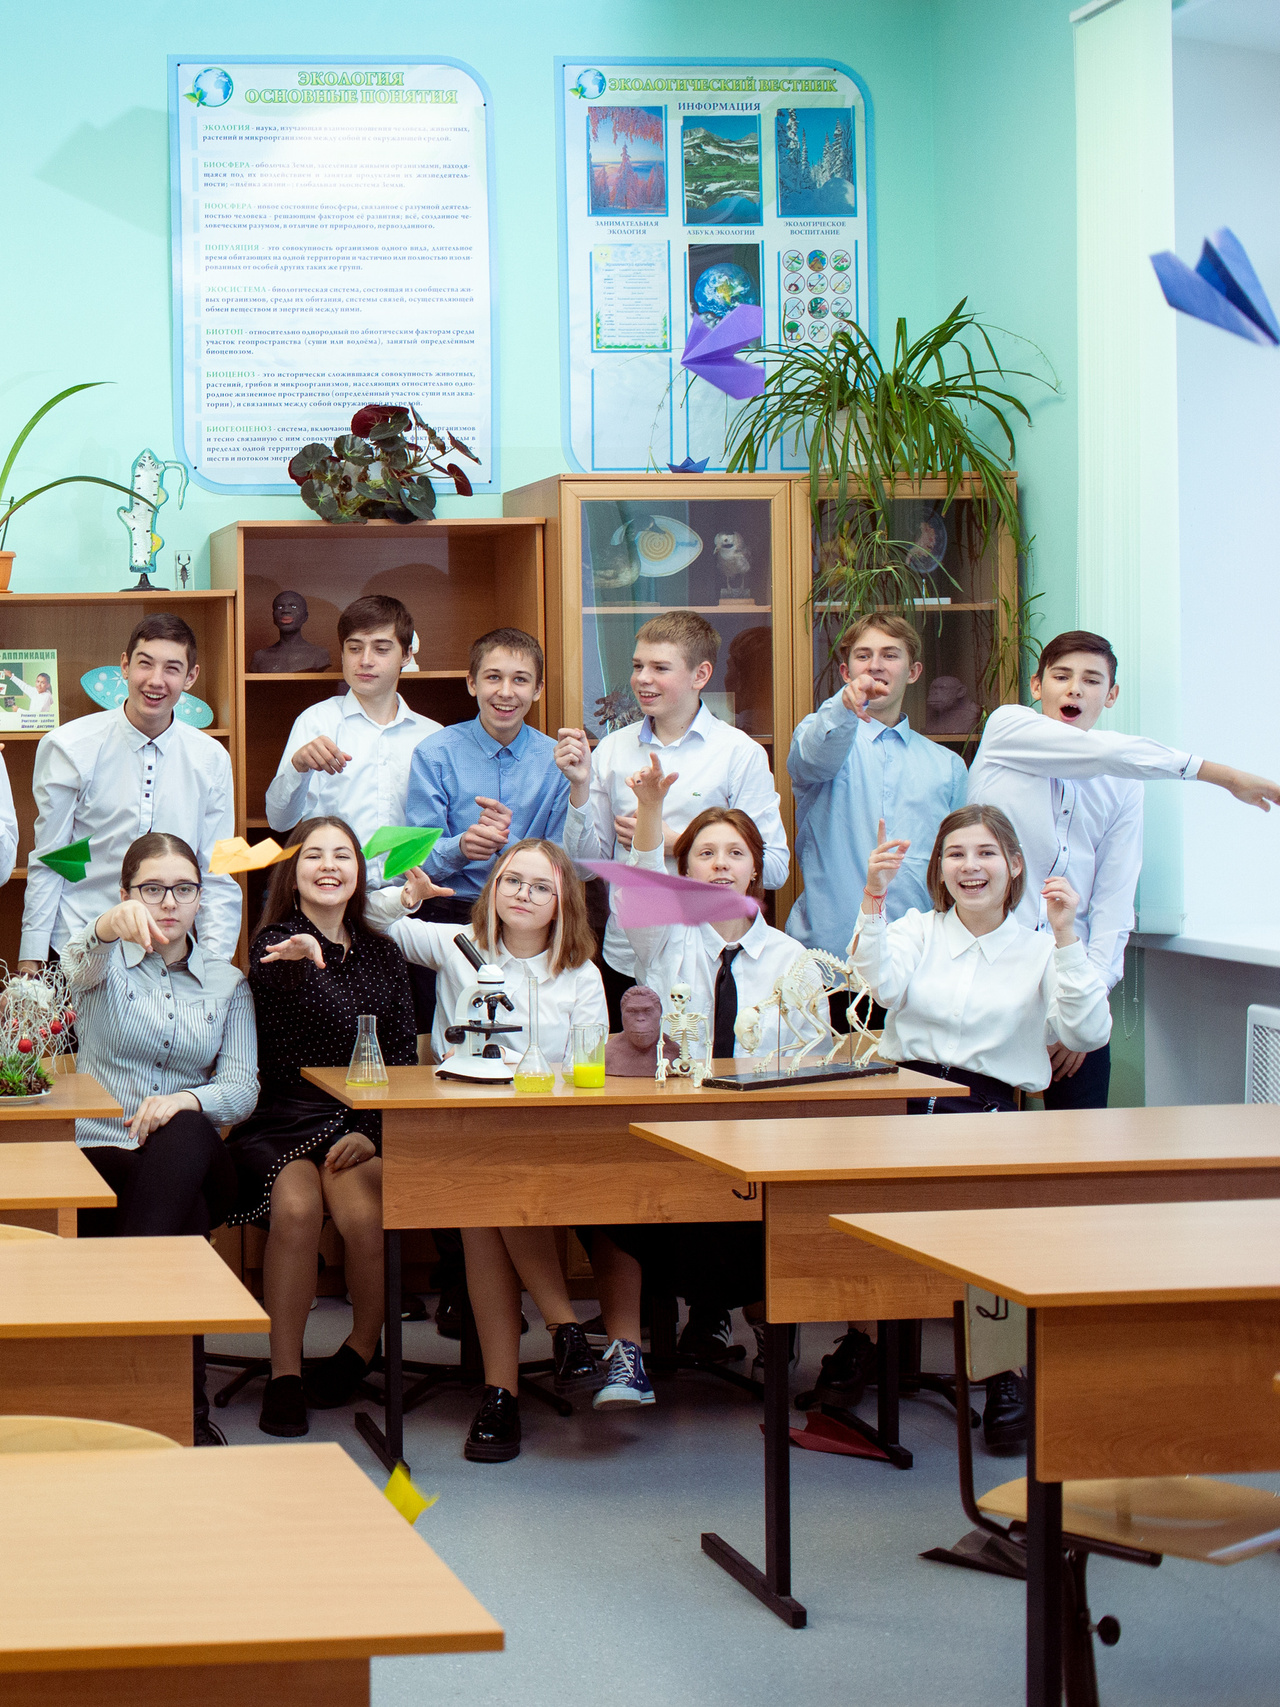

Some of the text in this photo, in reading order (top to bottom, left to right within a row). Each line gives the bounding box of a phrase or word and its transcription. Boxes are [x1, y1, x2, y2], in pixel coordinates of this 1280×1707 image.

[297, 71, 405, 86] ЭКОЛОГИЯ
[608, 76, 838, 92] ЭКОЛОГИЧЕСКИЙ ВЕСТНИК
[244, 88, 458, 104] ОСНОВНЫЕ ПОНЯТИЯ
[677, 102, 761, 112] ИНФОРМАЦИЯ
